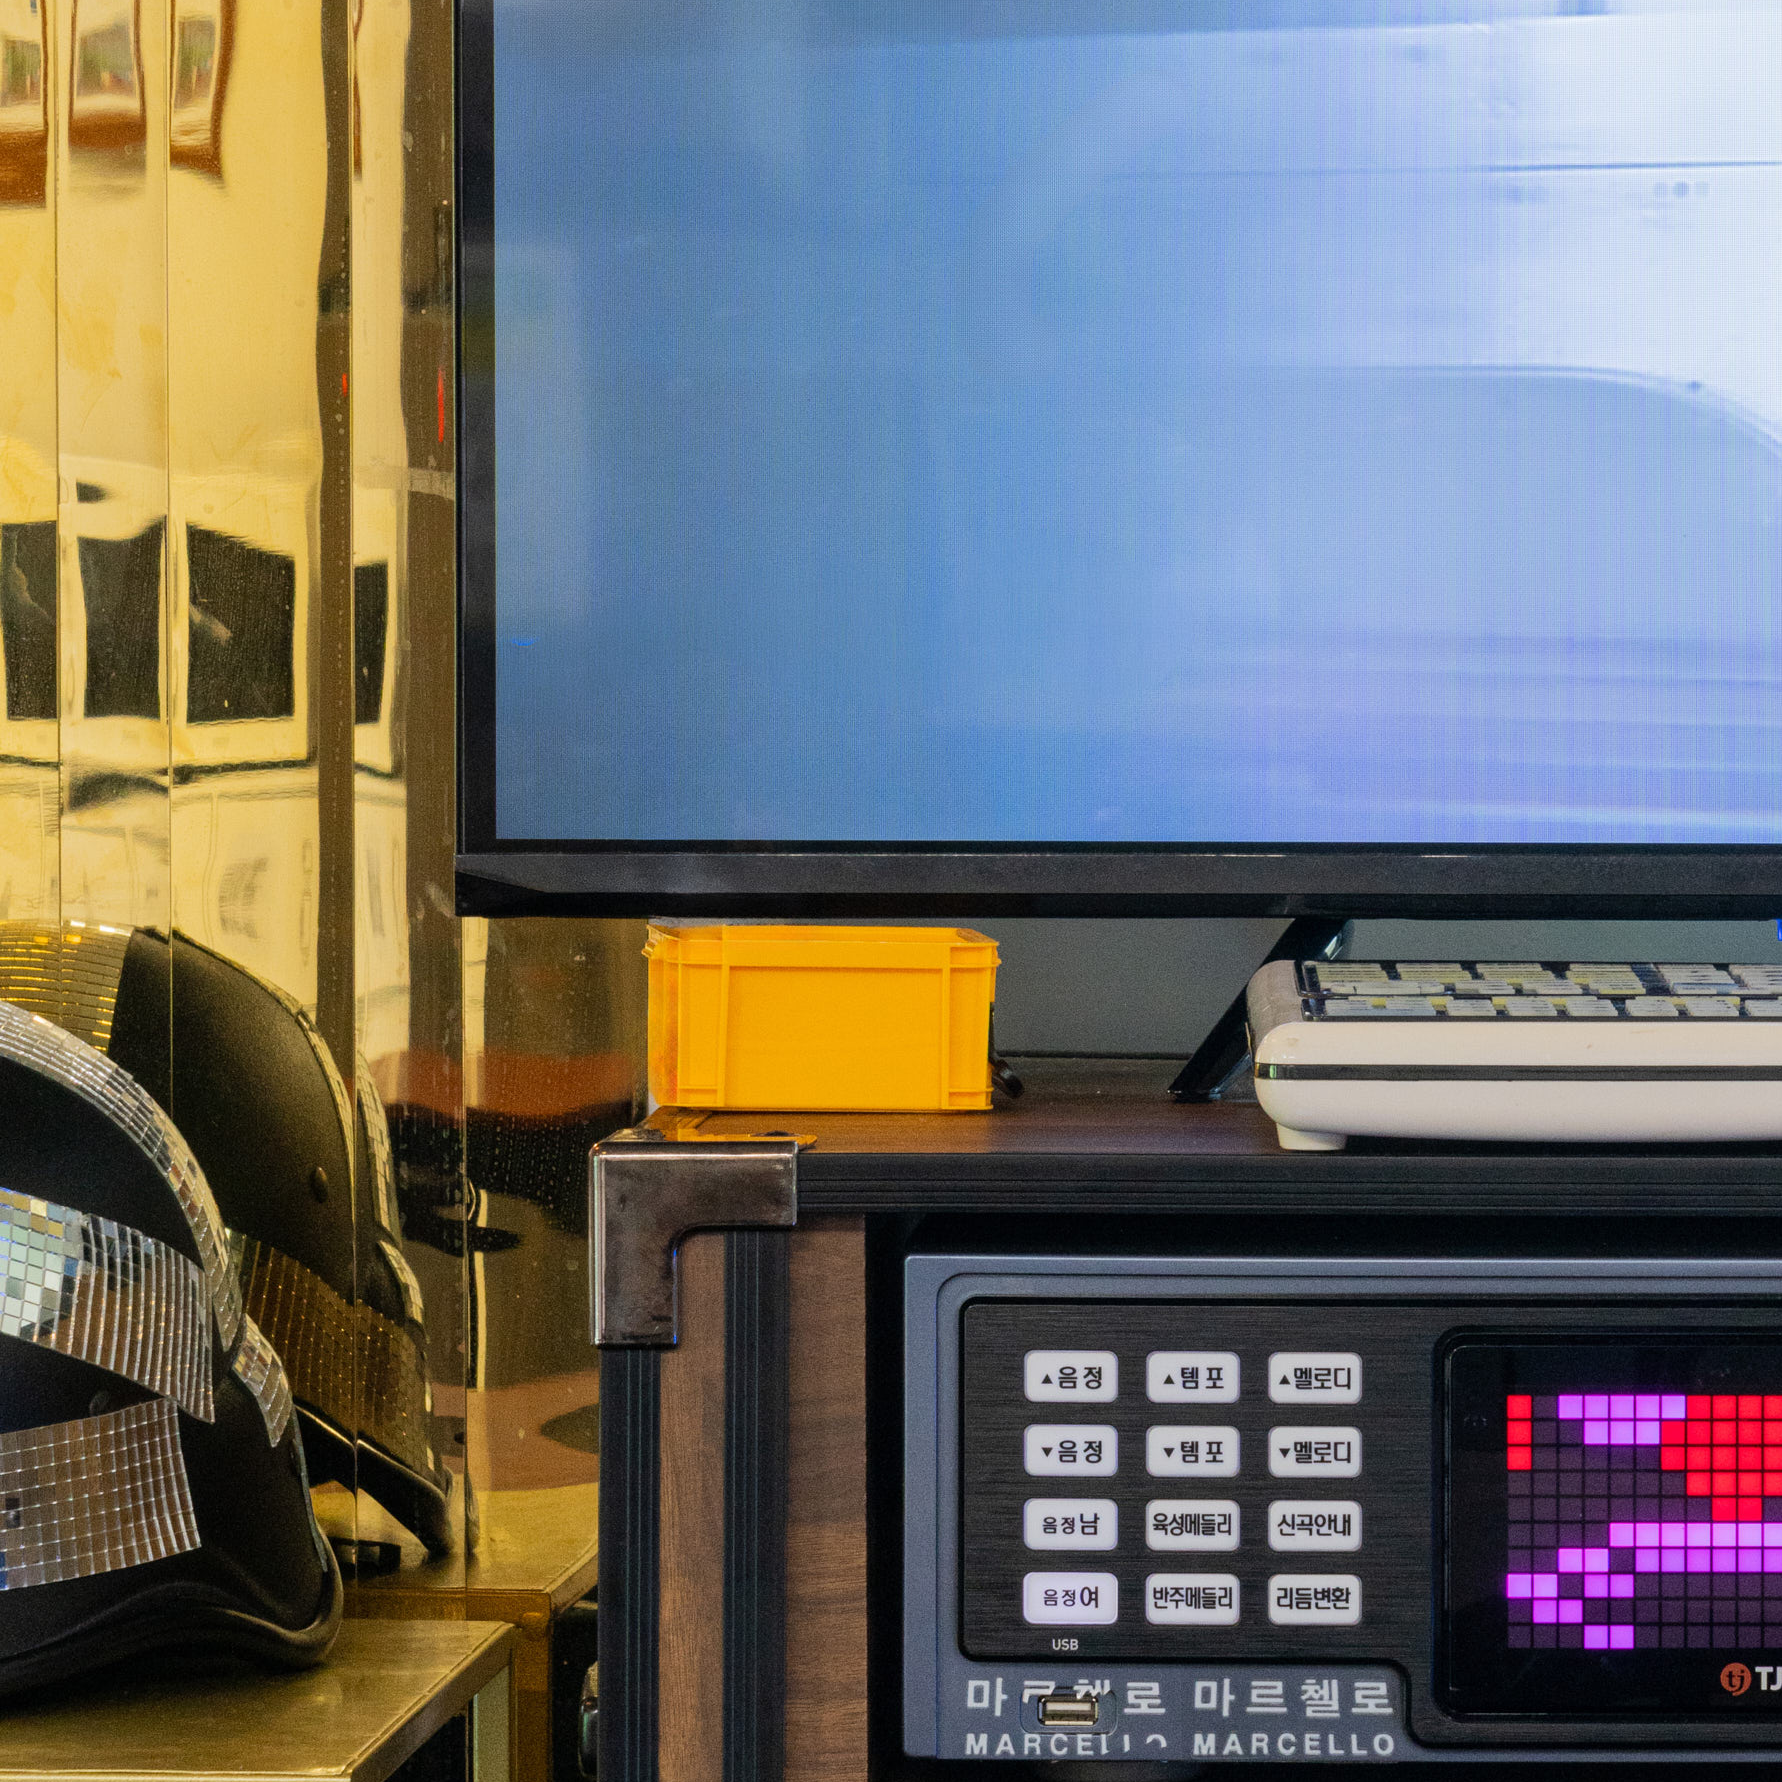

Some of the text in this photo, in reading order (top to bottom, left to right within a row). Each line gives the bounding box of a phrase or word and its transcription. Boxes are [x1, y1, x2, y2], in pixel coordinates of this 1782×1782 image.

[1293, 1367, 1352, 1391] 멜로디
[1293, 1441, 1352, 1465] 멜로디
[1152, 1512, 1232, 1537] 육성메들리
[1277, 1513, 1352, 1537] 신곡안내
[1152, 1586, 1233, 1611] 반주메들리
[1276, 1586, 1351, 1611] 리듬변환
[1052, 1638, 1079, 1651] USB
[1755, 1666, 1782, 1691] TJ
[1194, 1677, 1395, 1718] 마르첼로
[1193, 1733, 1395, 1757] MARCELLO
